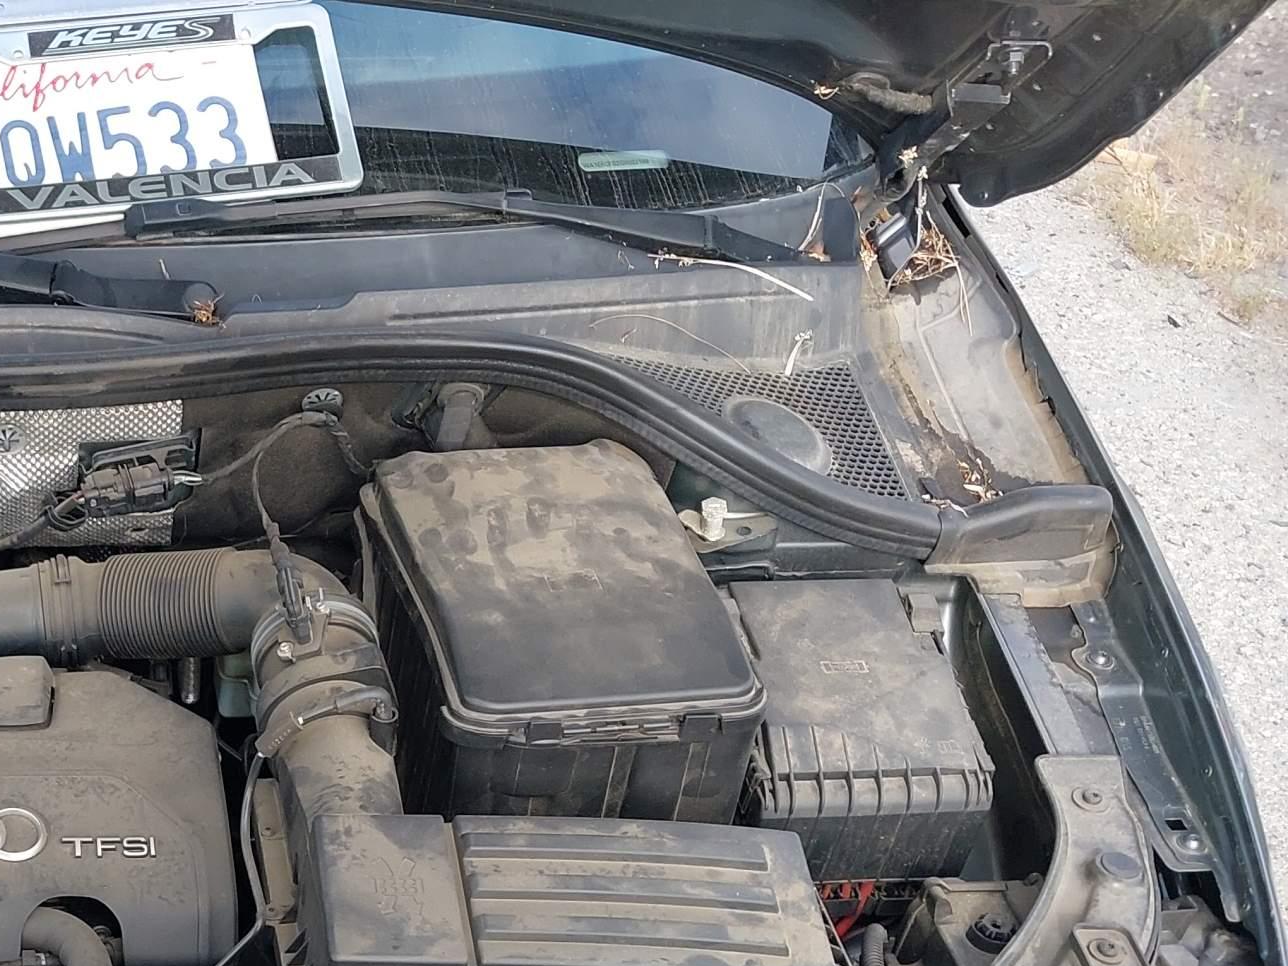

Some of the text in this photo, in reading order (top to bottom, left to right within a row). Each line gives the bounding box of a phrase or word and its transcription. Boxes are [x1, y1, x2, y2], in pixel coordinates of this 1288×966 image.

[46, 16, 220, 51] KEYES
[6, 162, 315, 210] VALENCIA
[60, 836, 158, 859] TFSI
